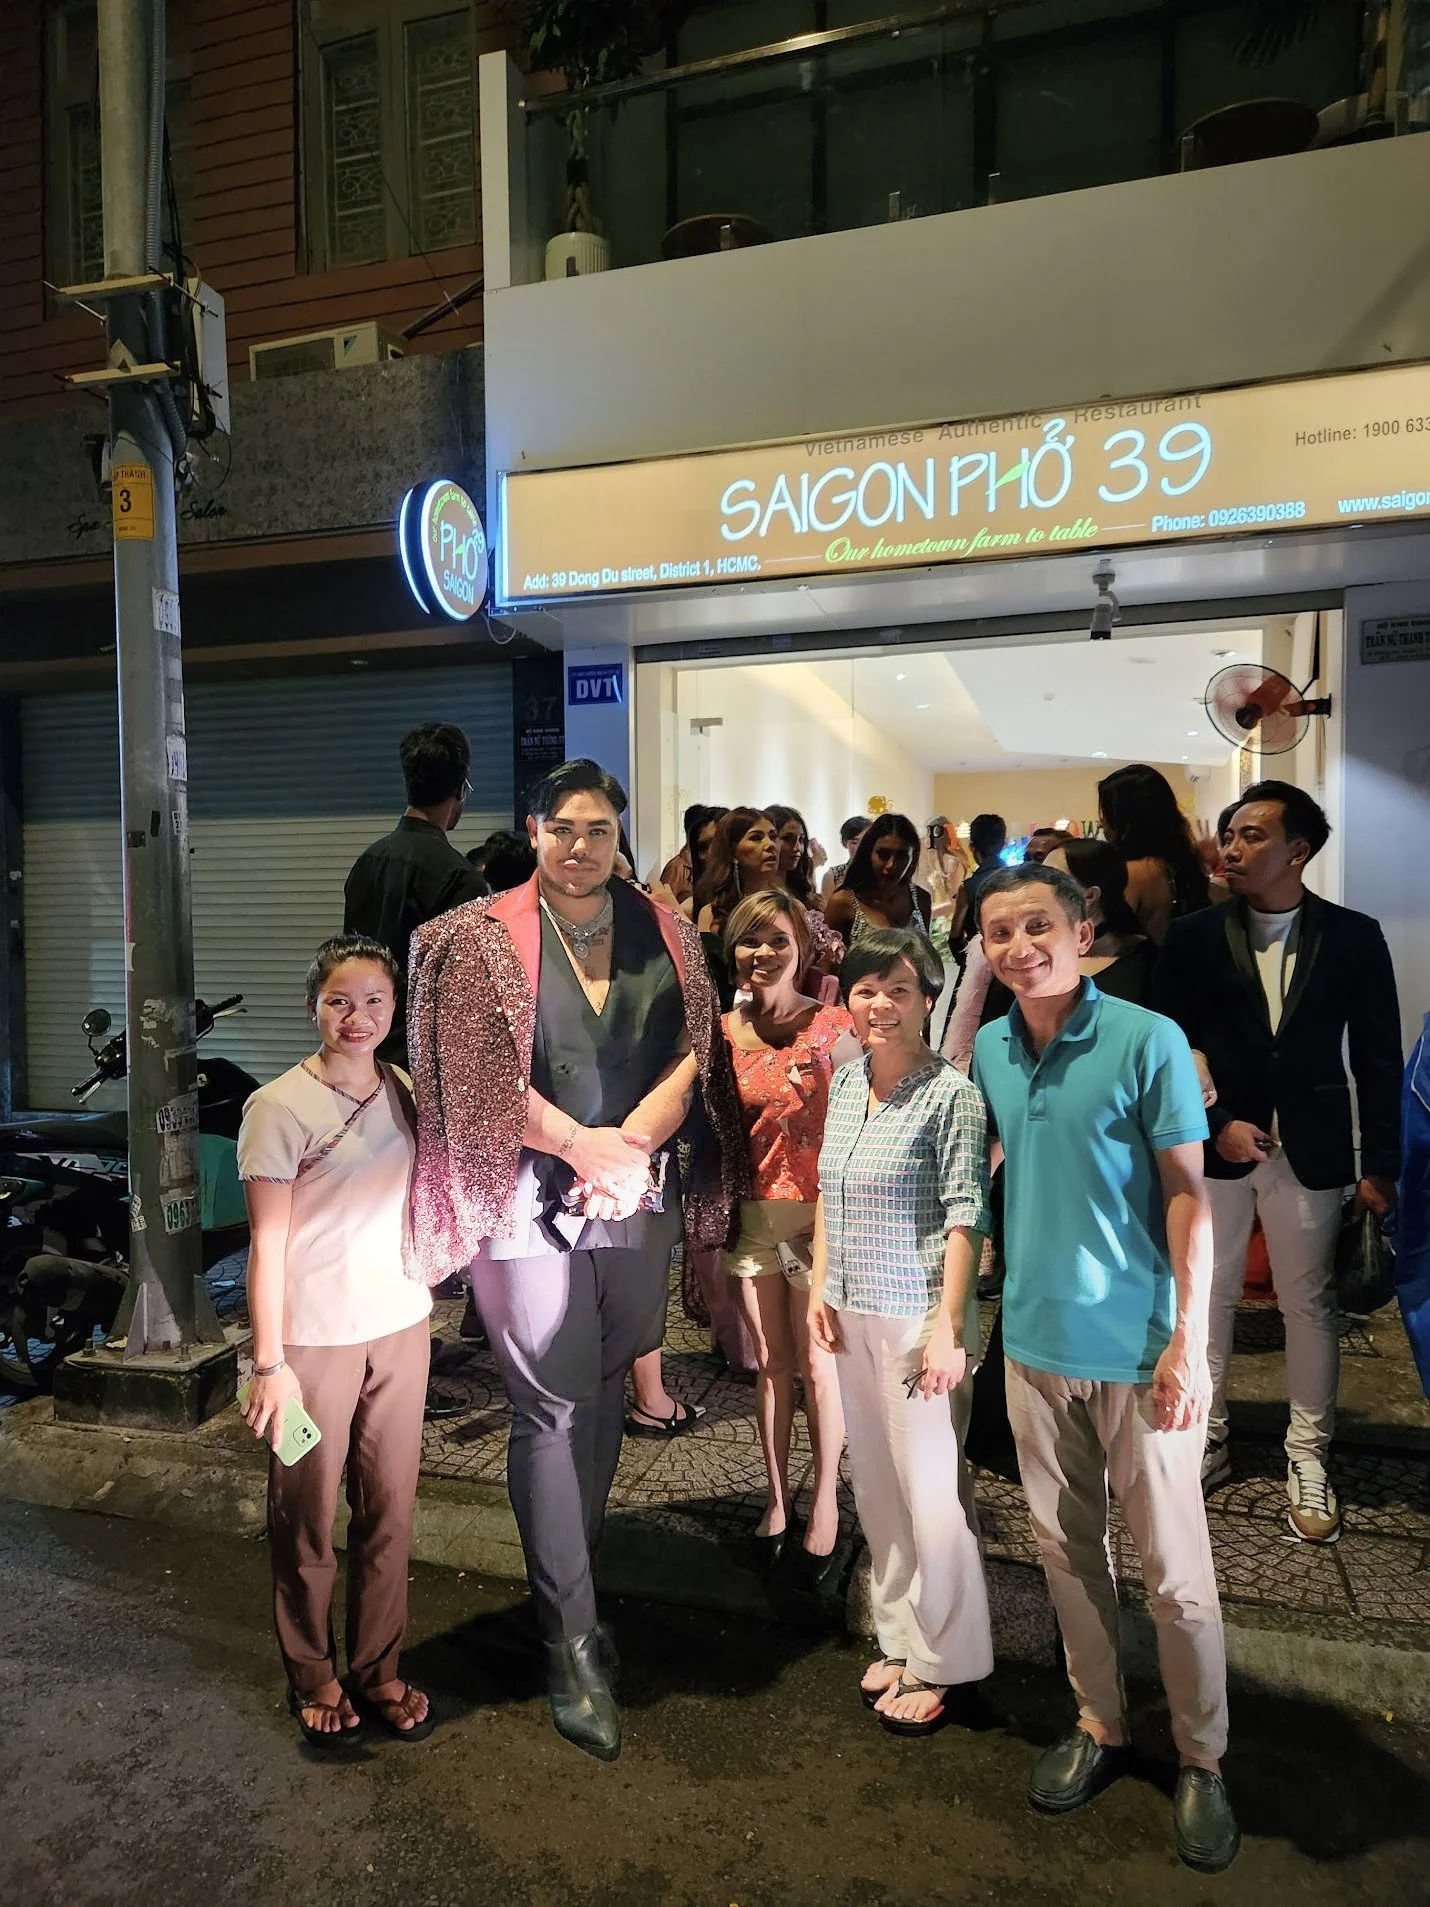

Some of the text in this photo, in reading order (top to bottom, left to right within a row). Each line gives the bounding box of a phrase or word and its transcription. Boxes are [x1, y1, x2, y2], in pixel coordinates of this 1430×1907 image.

[804, 393, 1203, 457] Vietnamese Authentic Restaurant
[1295, 428, 1357, 446] Hotline:
[1363, 420, 1400, 438] 1900
[719, 418, 1213, 541] SAIGON PHỞ 39
[120, 488, 132, 513] 3
[180, 499, 228, 520] Salon
[1151, 501, 1307, 532] Phone: 0926390388
[825, 517, 1099, 563] Our hometown farm to table
[443, 569, 474, 605] SAIGON
[523, 574, 550, 590] Add:
[551, 572, 567, 587] 39
[568, 570, 600, 588] Dong
[602, 567, 619, 582] Du
[621, 564, 658, 581] street,
[660, 560, 701, 578] District
[703, 559, 715, 576] 1,
